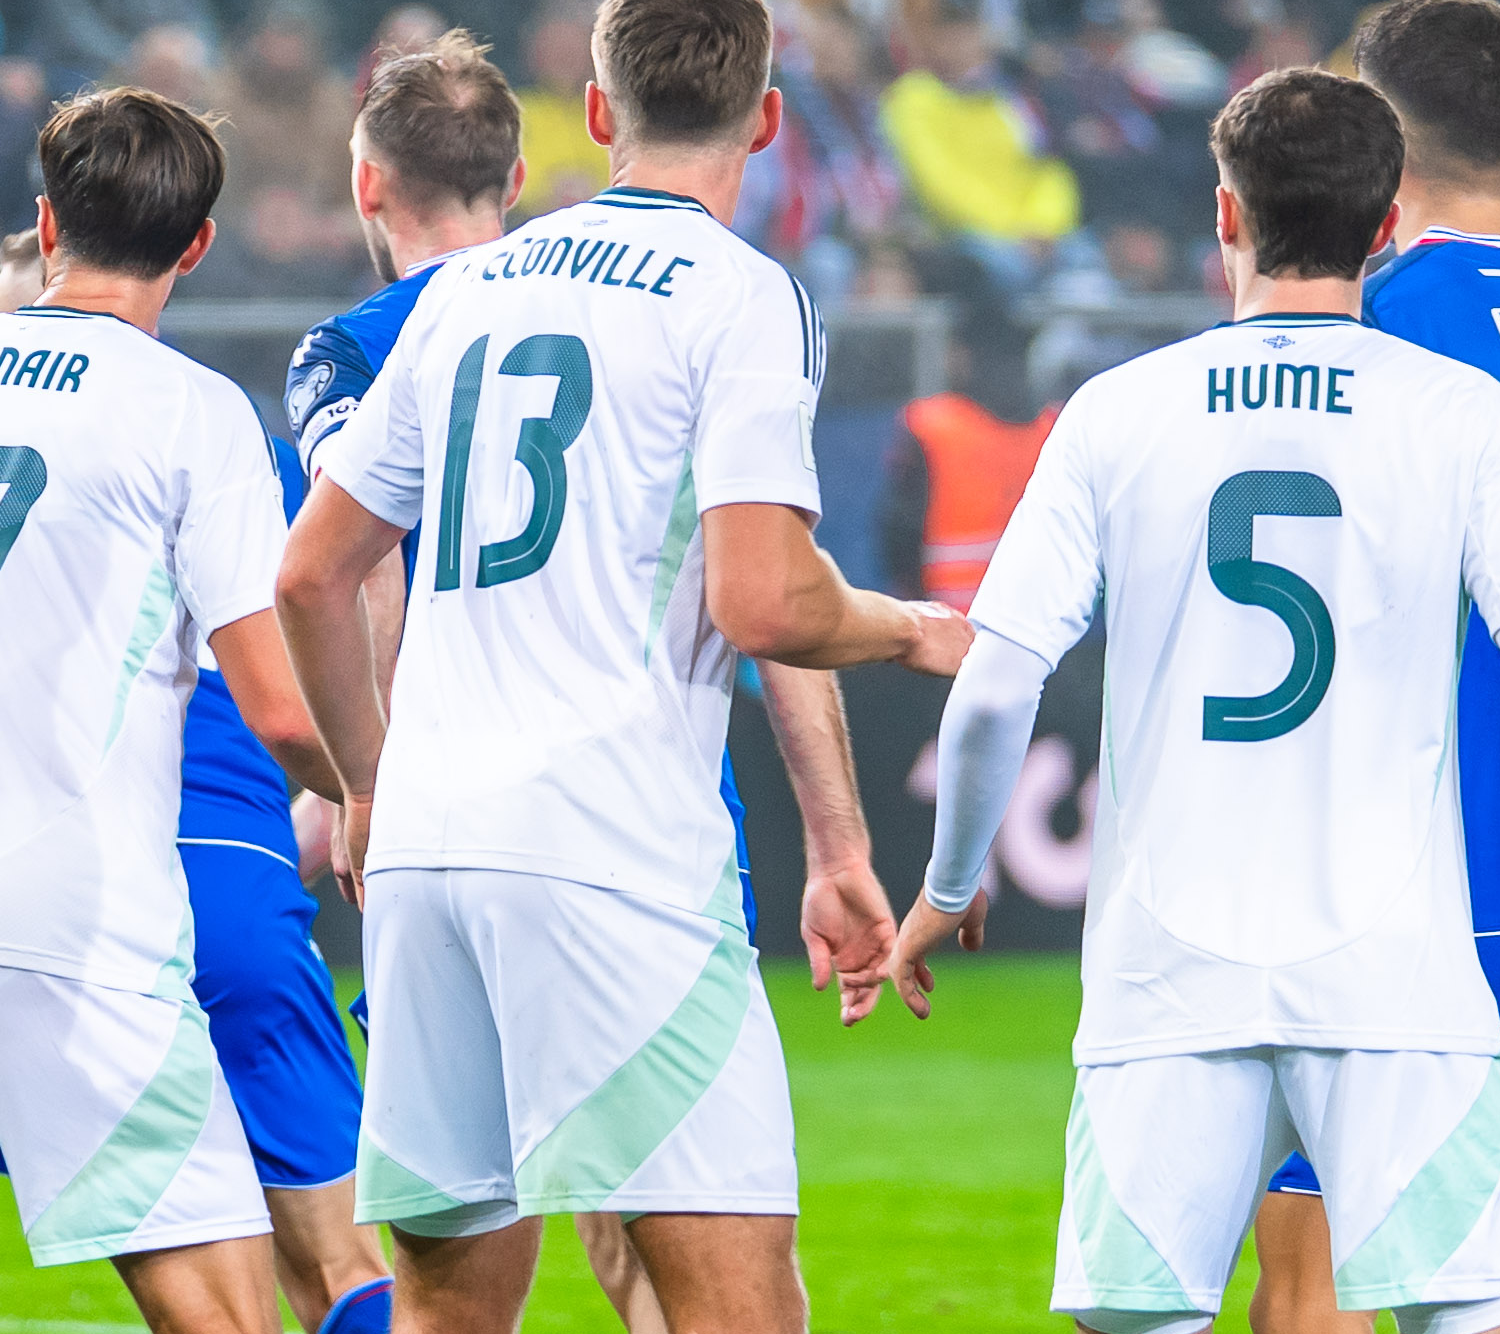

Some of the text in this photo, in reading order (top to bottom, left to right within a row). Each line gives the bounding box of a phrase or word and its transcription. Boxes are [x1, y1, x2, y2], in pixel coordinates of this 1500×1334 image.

[433, 333, 593, 592] 13
[1207, 362, 1355, 415] HUME
[1202, 470, 1343, 743] 5
